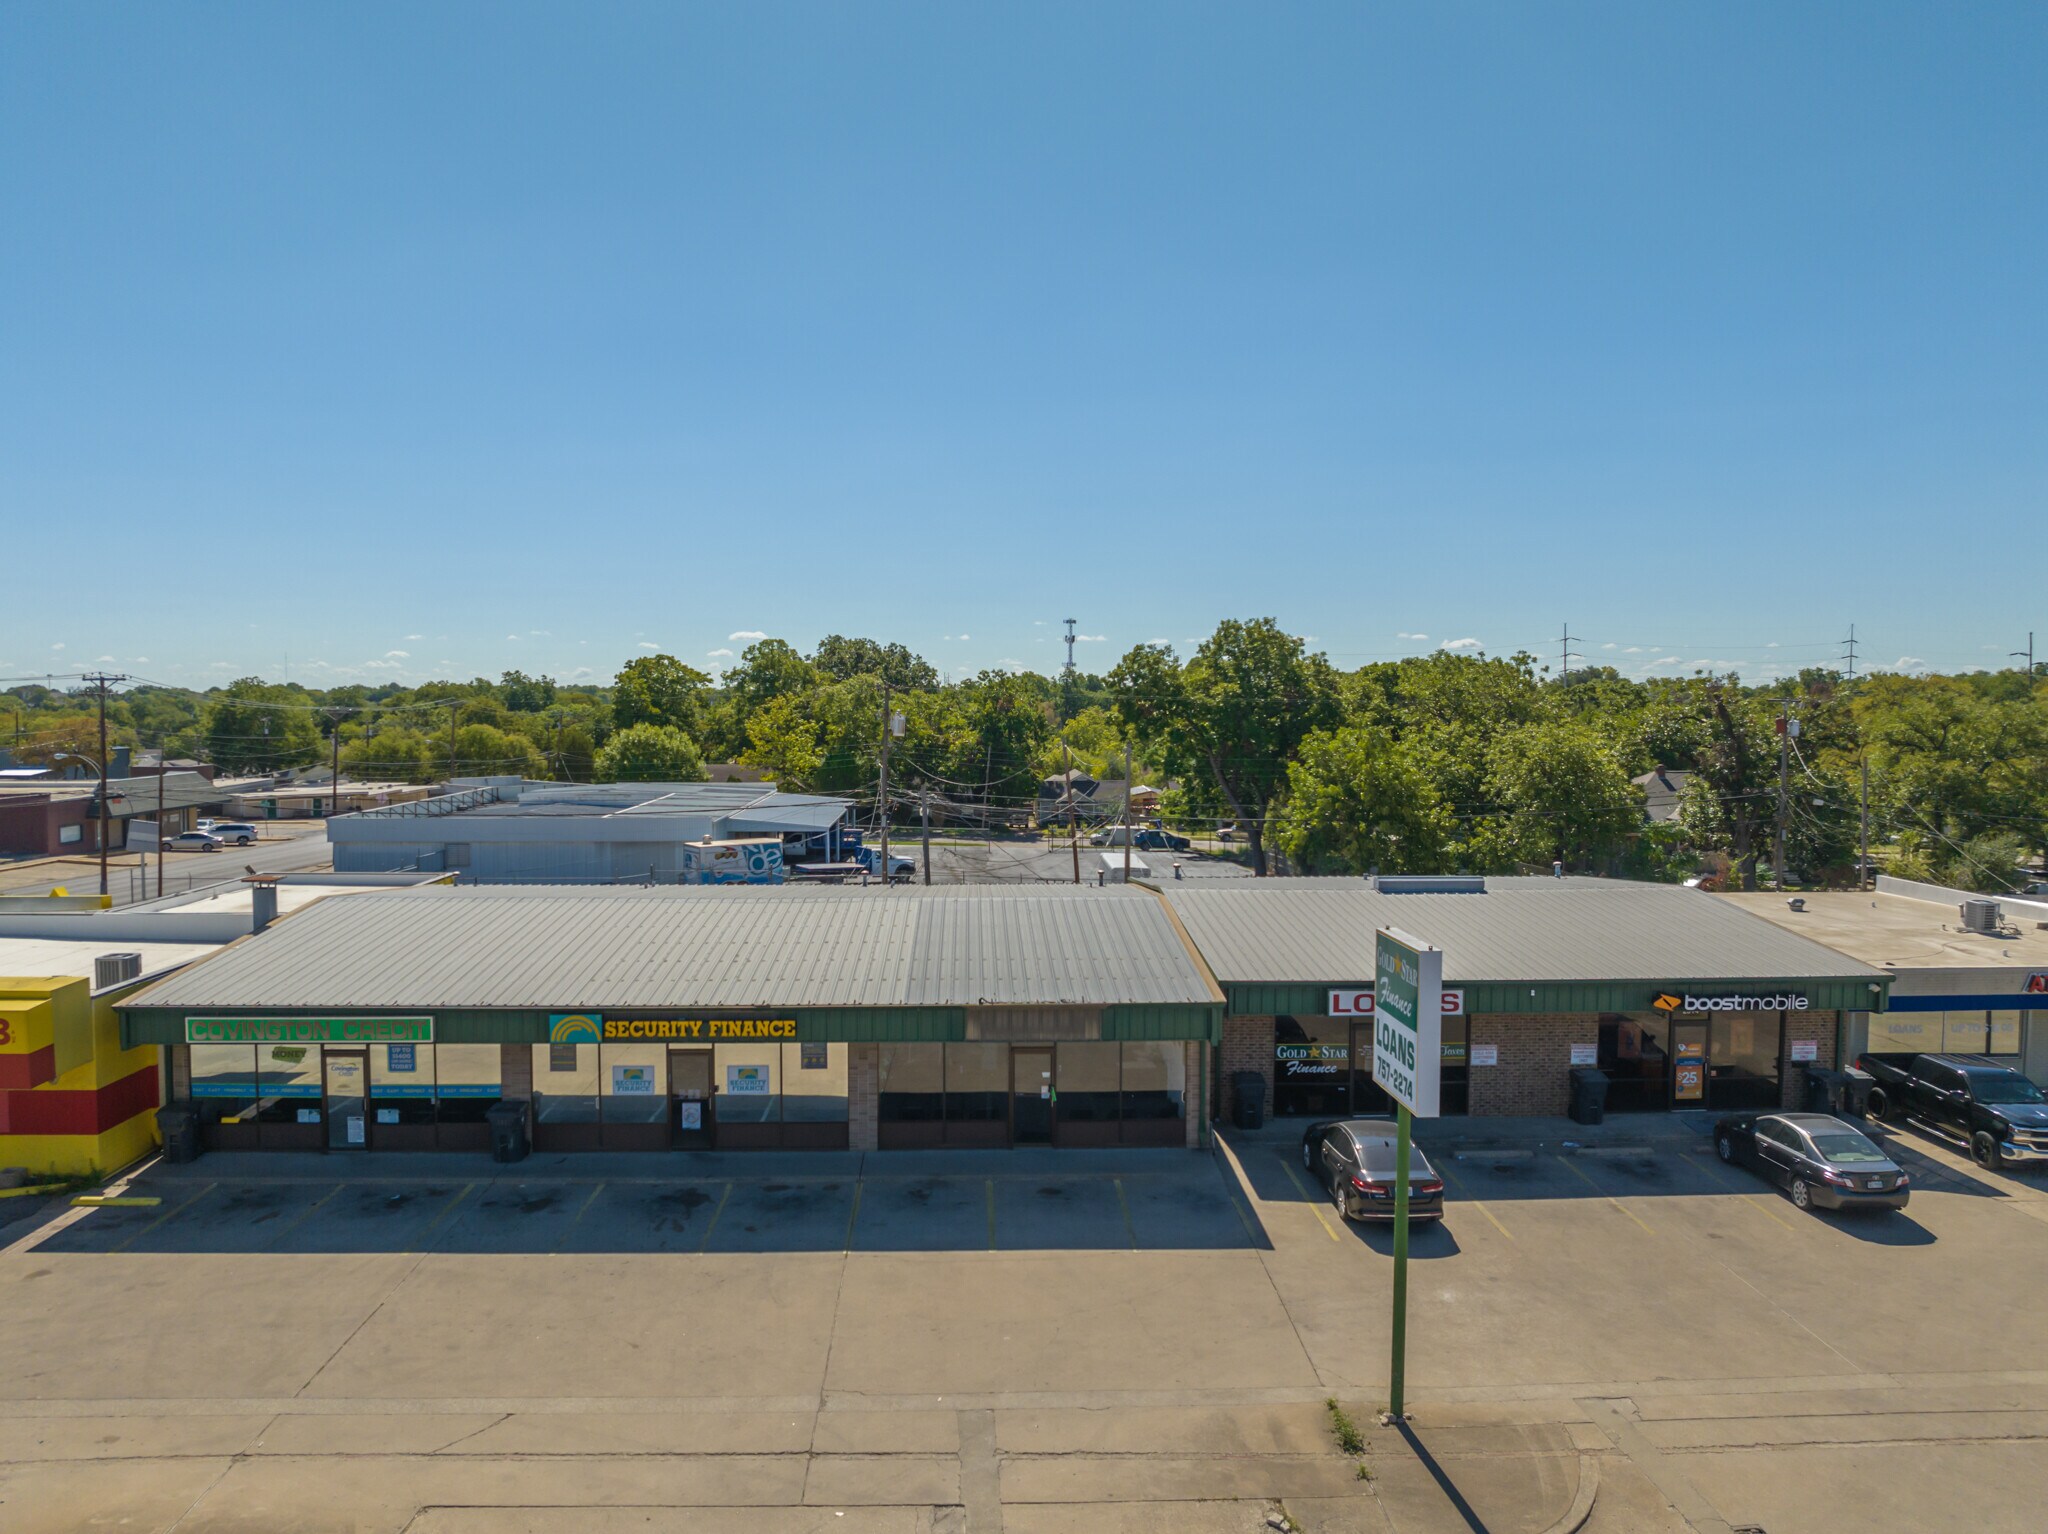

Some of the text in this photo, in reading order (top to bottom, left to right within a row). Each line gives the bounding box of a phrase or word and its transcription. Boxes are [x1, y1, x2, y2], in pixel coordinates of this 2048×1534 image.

[1377, 946, 1418, 987] GOLD STAR
[1332, 993, 1460, 1013] LOS
[1380, 976, 1412, 1017] Finance
[1684, 994, 1809, 1011] boostmobile
[191, 1021, 427, 1040] COVINGTON CREDIT
[604, 1020, 796, 1038] SECURITY FINANCE
[272, 1049, 307, 1059] MONEY
[1276, 1045, 1307, 1059] GOLD
[1321, 1045, 1348, 1059] STAR
[1376, 1018, 1415, 1072] LOANS
[1286, 1060, 1338, 1076] Finance
[1377, 1055, 1413, 1102] 757-2274
[1677, 1071, 1698, 1084] $25
